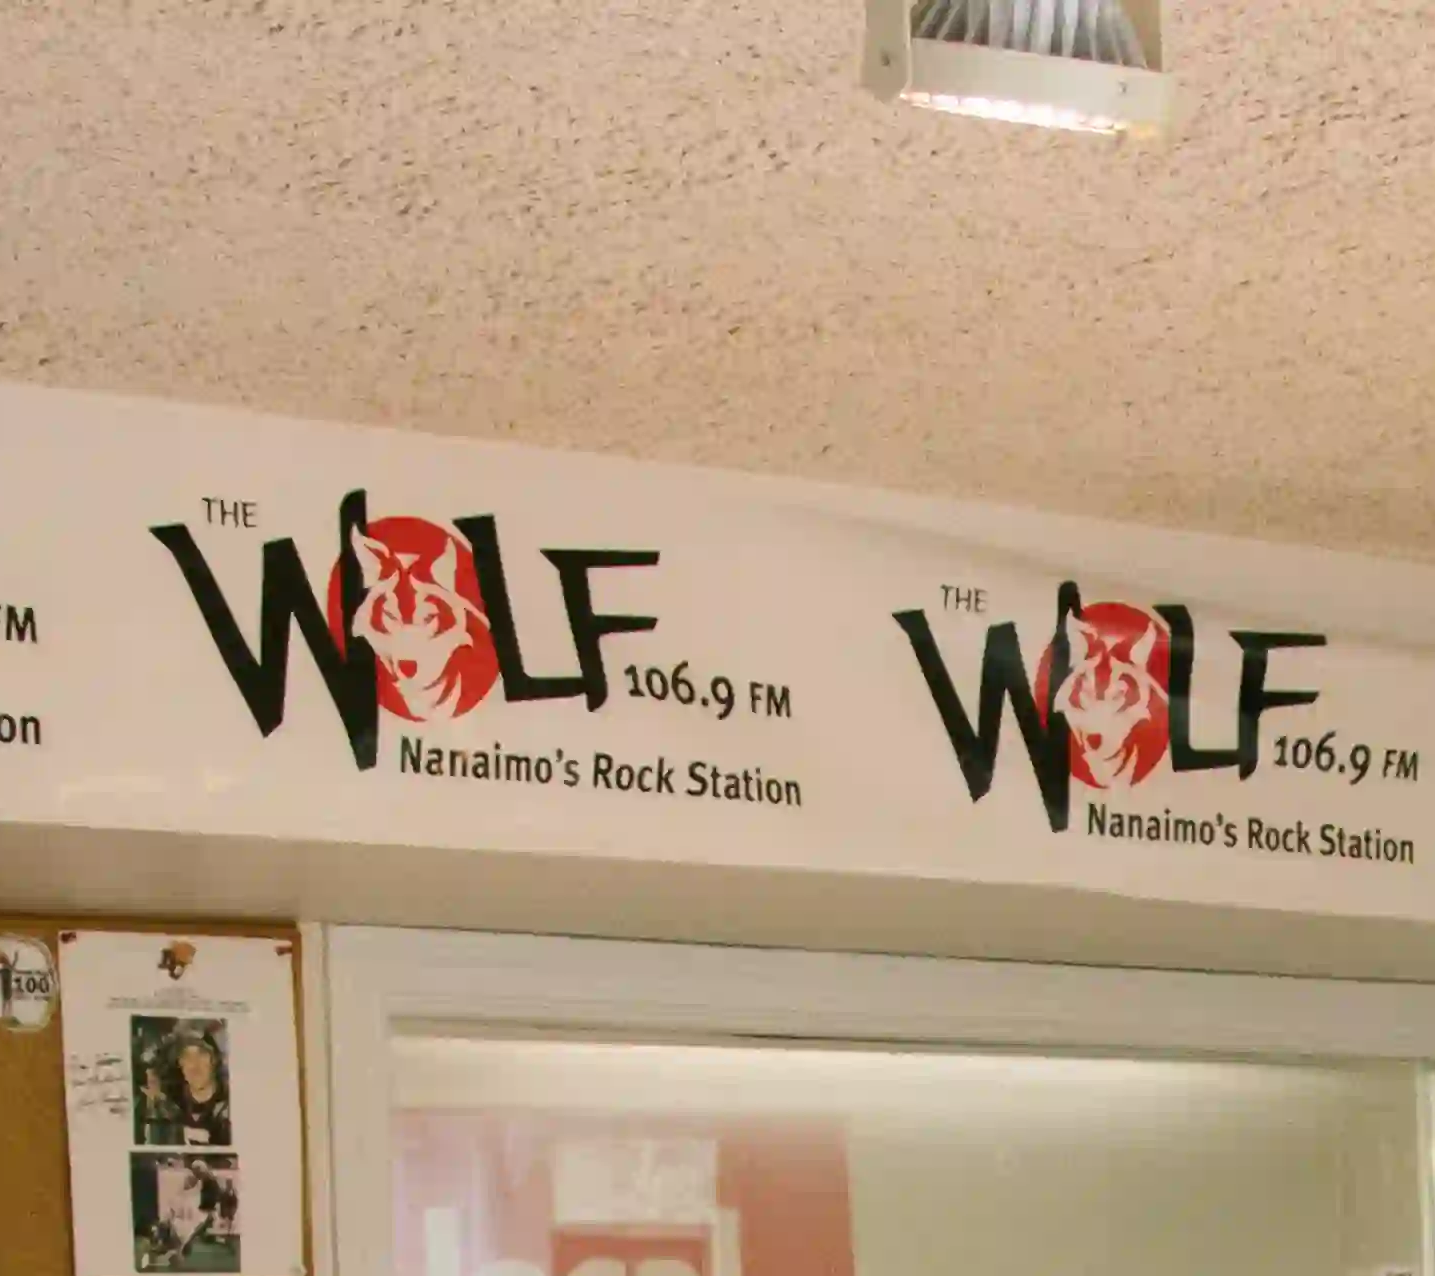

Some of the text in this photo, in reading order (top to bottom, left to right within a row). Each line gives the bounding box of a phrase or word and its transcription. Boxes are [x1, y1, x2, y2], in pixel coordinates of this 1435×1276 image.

[201, 497, 257, 528] THE
[148, 488, 661, 770] WOLF
[940, 584, 988, 613] THE
[624, 661, 791, 720] 106.9 FM
[891, 580, 1326, 834] WOLF
[400, 736, 801, 808] Nanaimo's Rock Station
[1274, 733, 1418, 786] 106.9 FM
[1087, 801, 1414, 864] Nanaimo's Rock Station
